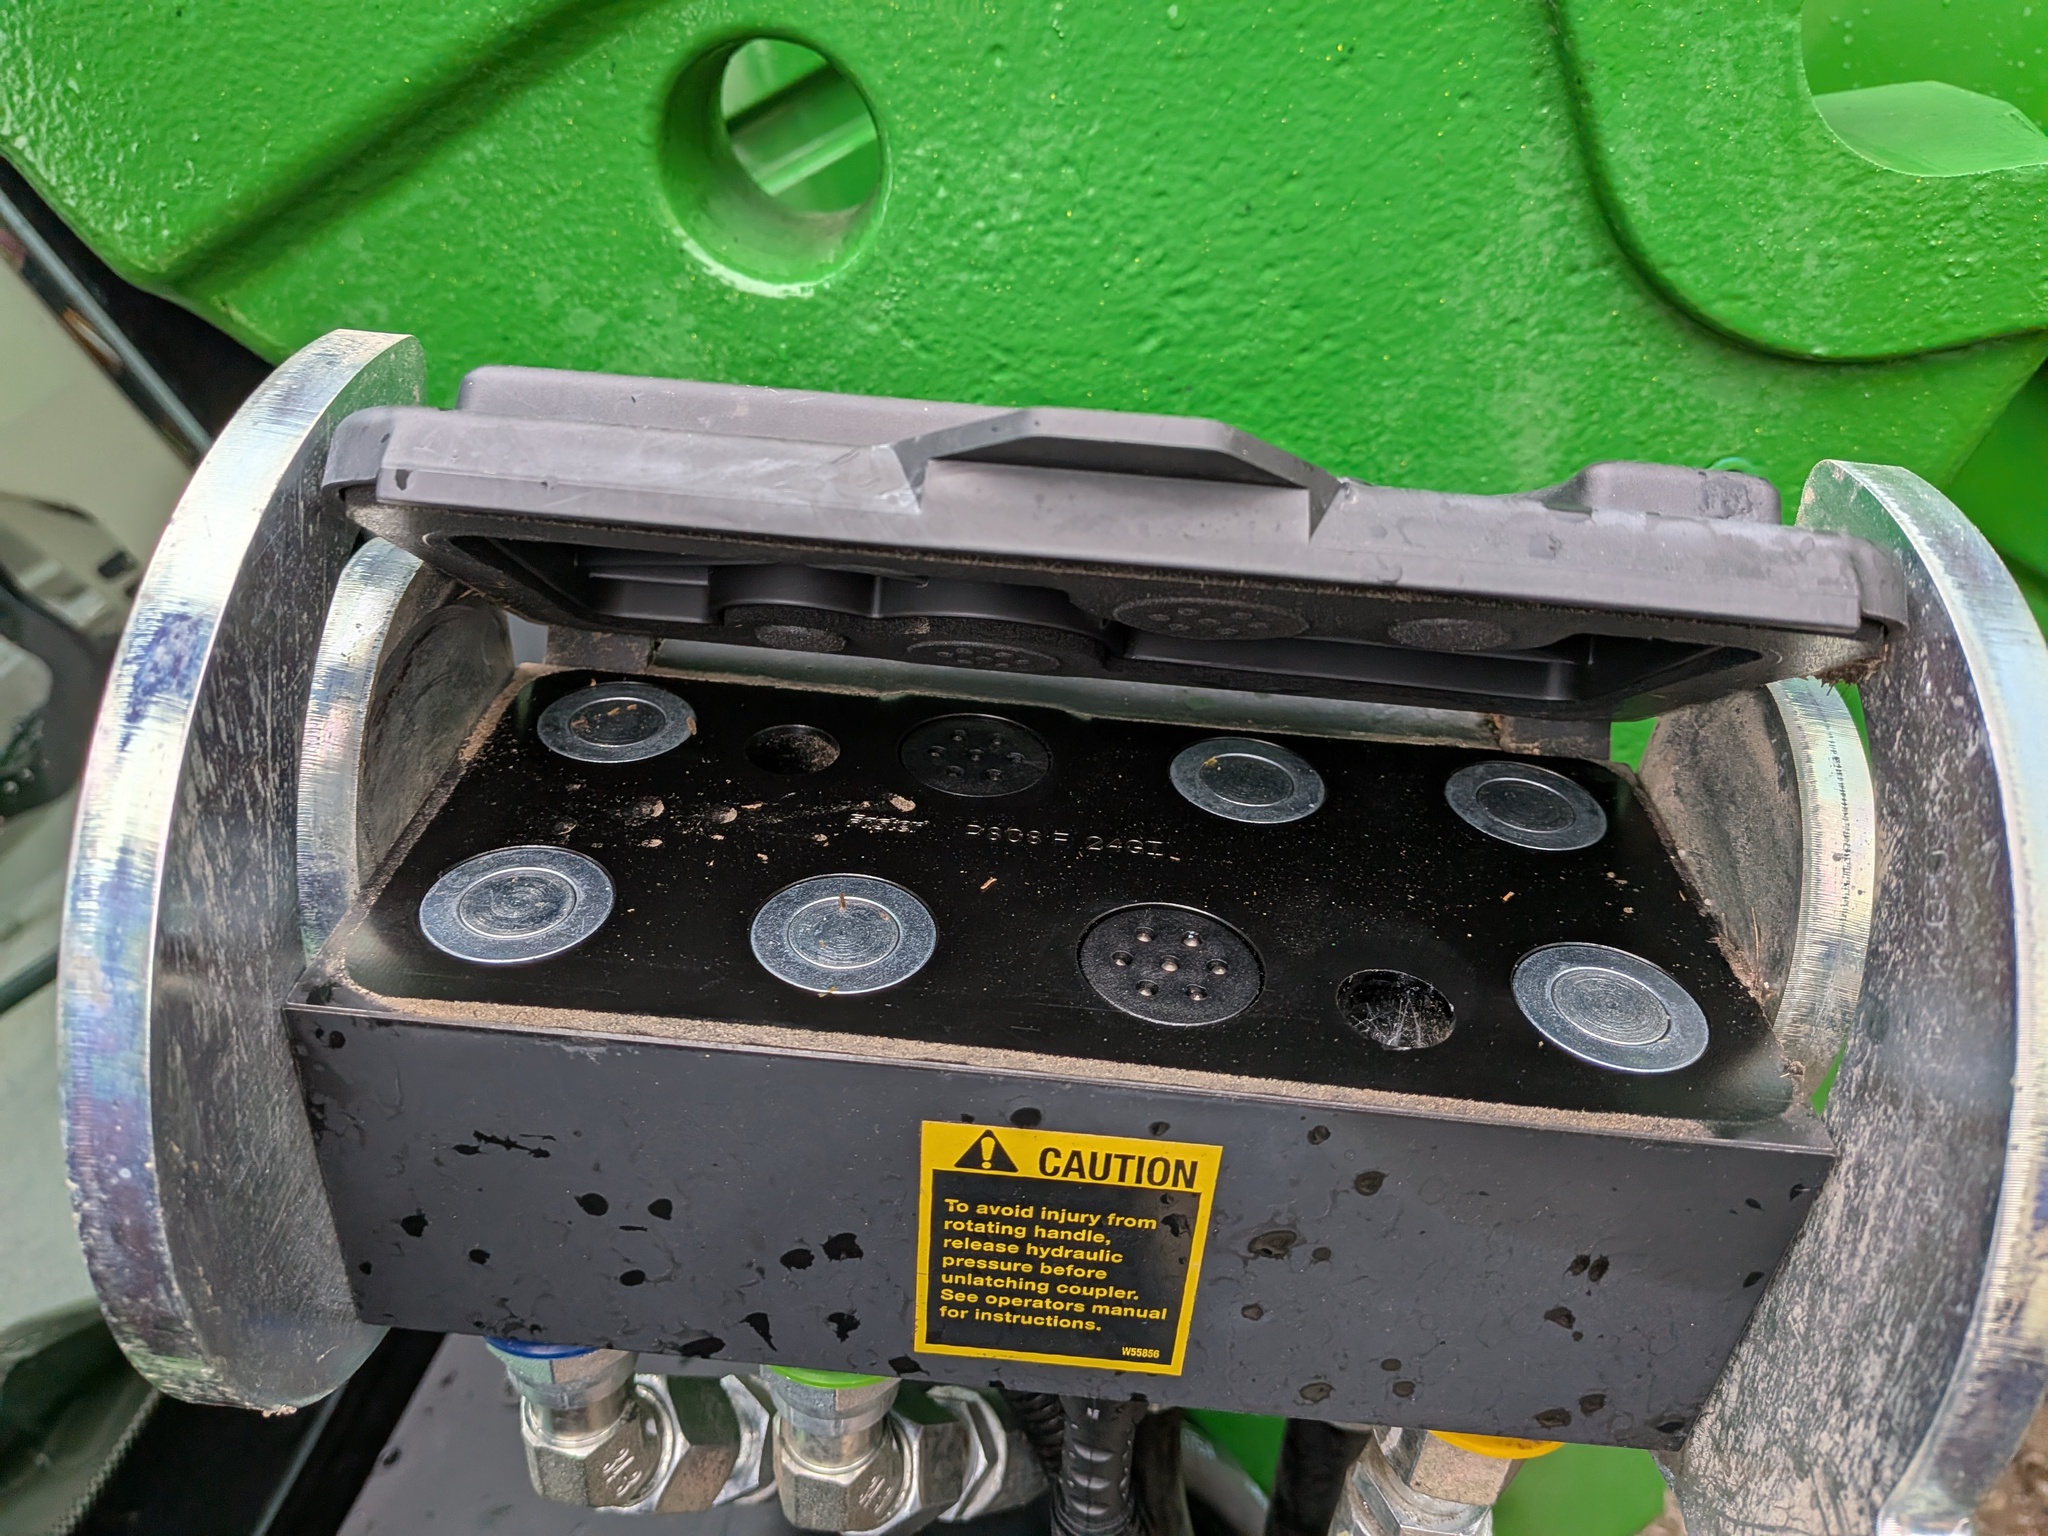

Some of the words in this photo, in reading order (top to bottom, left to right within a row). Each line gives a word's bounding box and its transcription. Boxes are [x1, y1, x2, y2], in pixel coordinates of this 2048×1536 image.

[1039, 1147, 1199, 1189] CAUTION
[944, 1198, 969, 1213] To
[976, 1203, 1034, 1219] avoid
[1040, 1207, 1102, 1227] injury
[1107, 1212, 1158, 1230] from
[943, 1218, 1027, 1239] rotating
[1034, 1225, 1112, 1246] handle,
[943, 1237, 1020, 1254] release
[1026, 1243, 1124, 1264] hydraulic
[942, 1255, 1034, 1273] pressure
[1040, 1262, 1108, 1280] before
[941, 1273, 1050, 1294] unlatching
[1056, 1282, 1140, 1300] coupler.
[940, 1288, 979, 1304] See
[985, 1292, 1086, 1313] operators
[1091, 1303, 1168, 1321] manual
[939, 1305, 969, 1320] for
[974, 1308, 1102, 1332] instructions.
